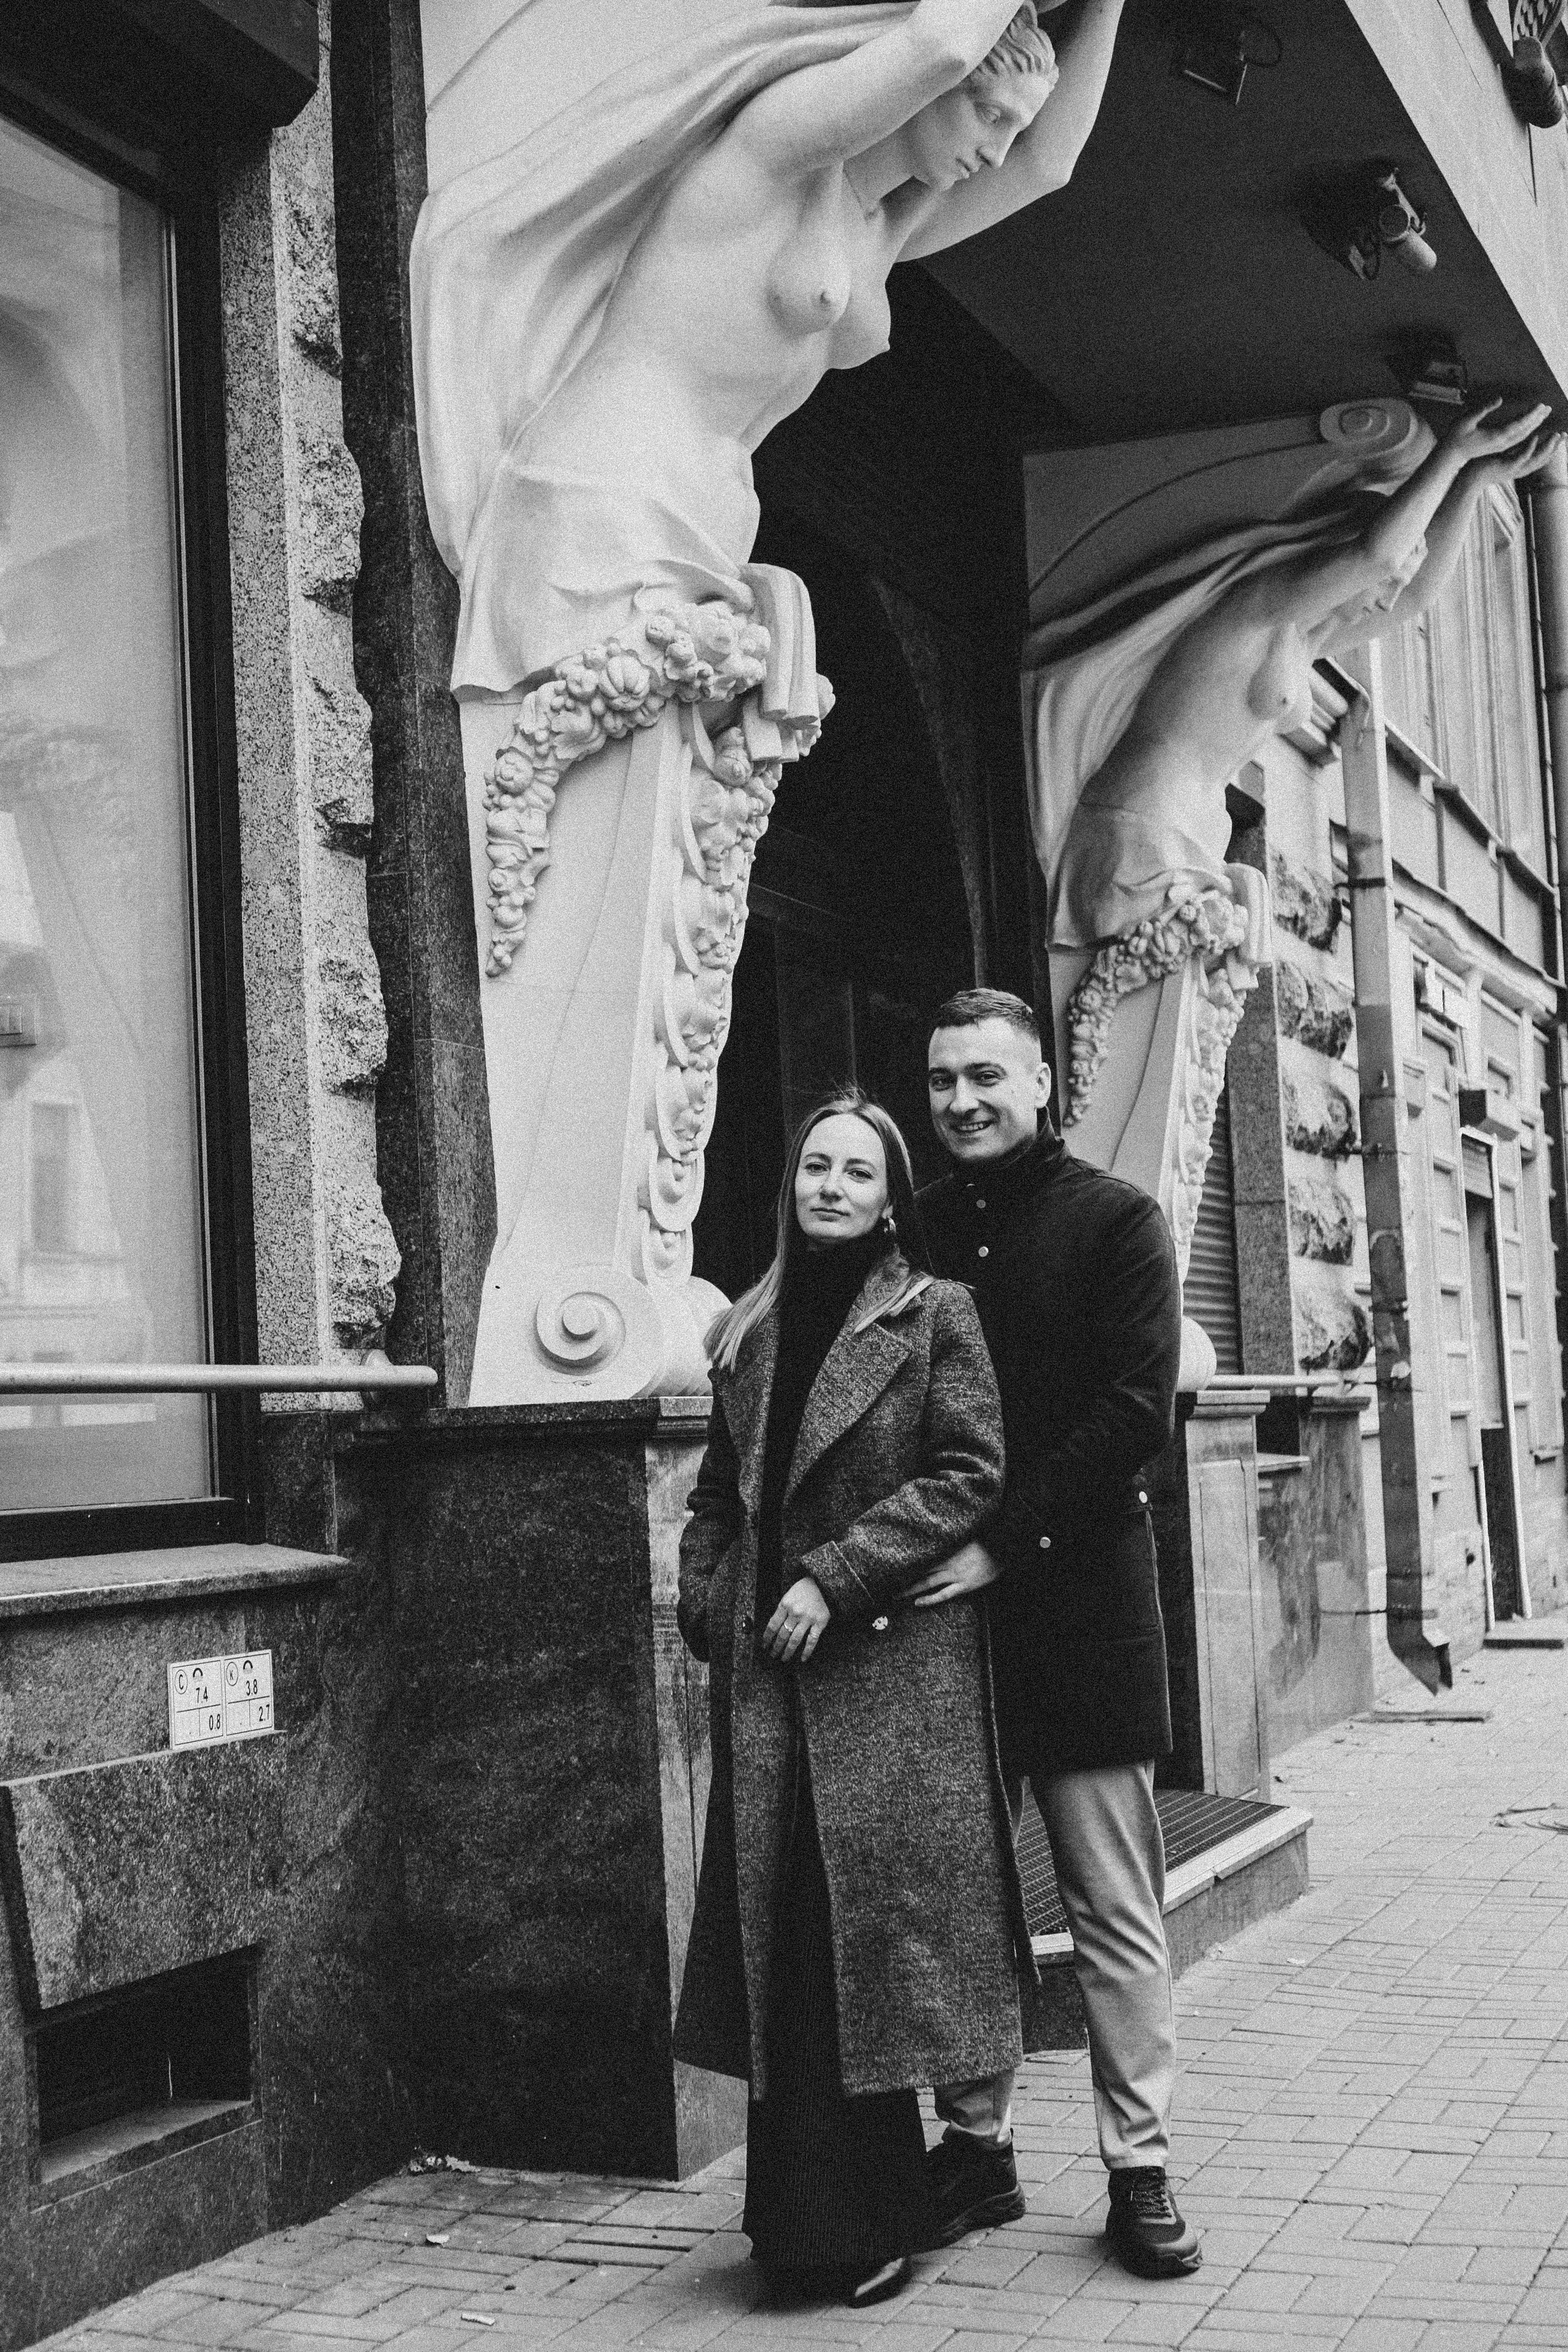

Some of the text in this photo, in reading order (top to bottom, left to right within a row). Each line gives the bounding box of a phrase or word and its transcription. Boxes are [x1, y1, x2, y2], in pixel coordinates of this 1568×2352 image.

[195, 1686, 208, 1703] 7.4
[246, 1678, 258, 1696] 3.8
[208, 1713, 221, 1731] 0.8
[258, 1704, 270, 1722] 2.7
